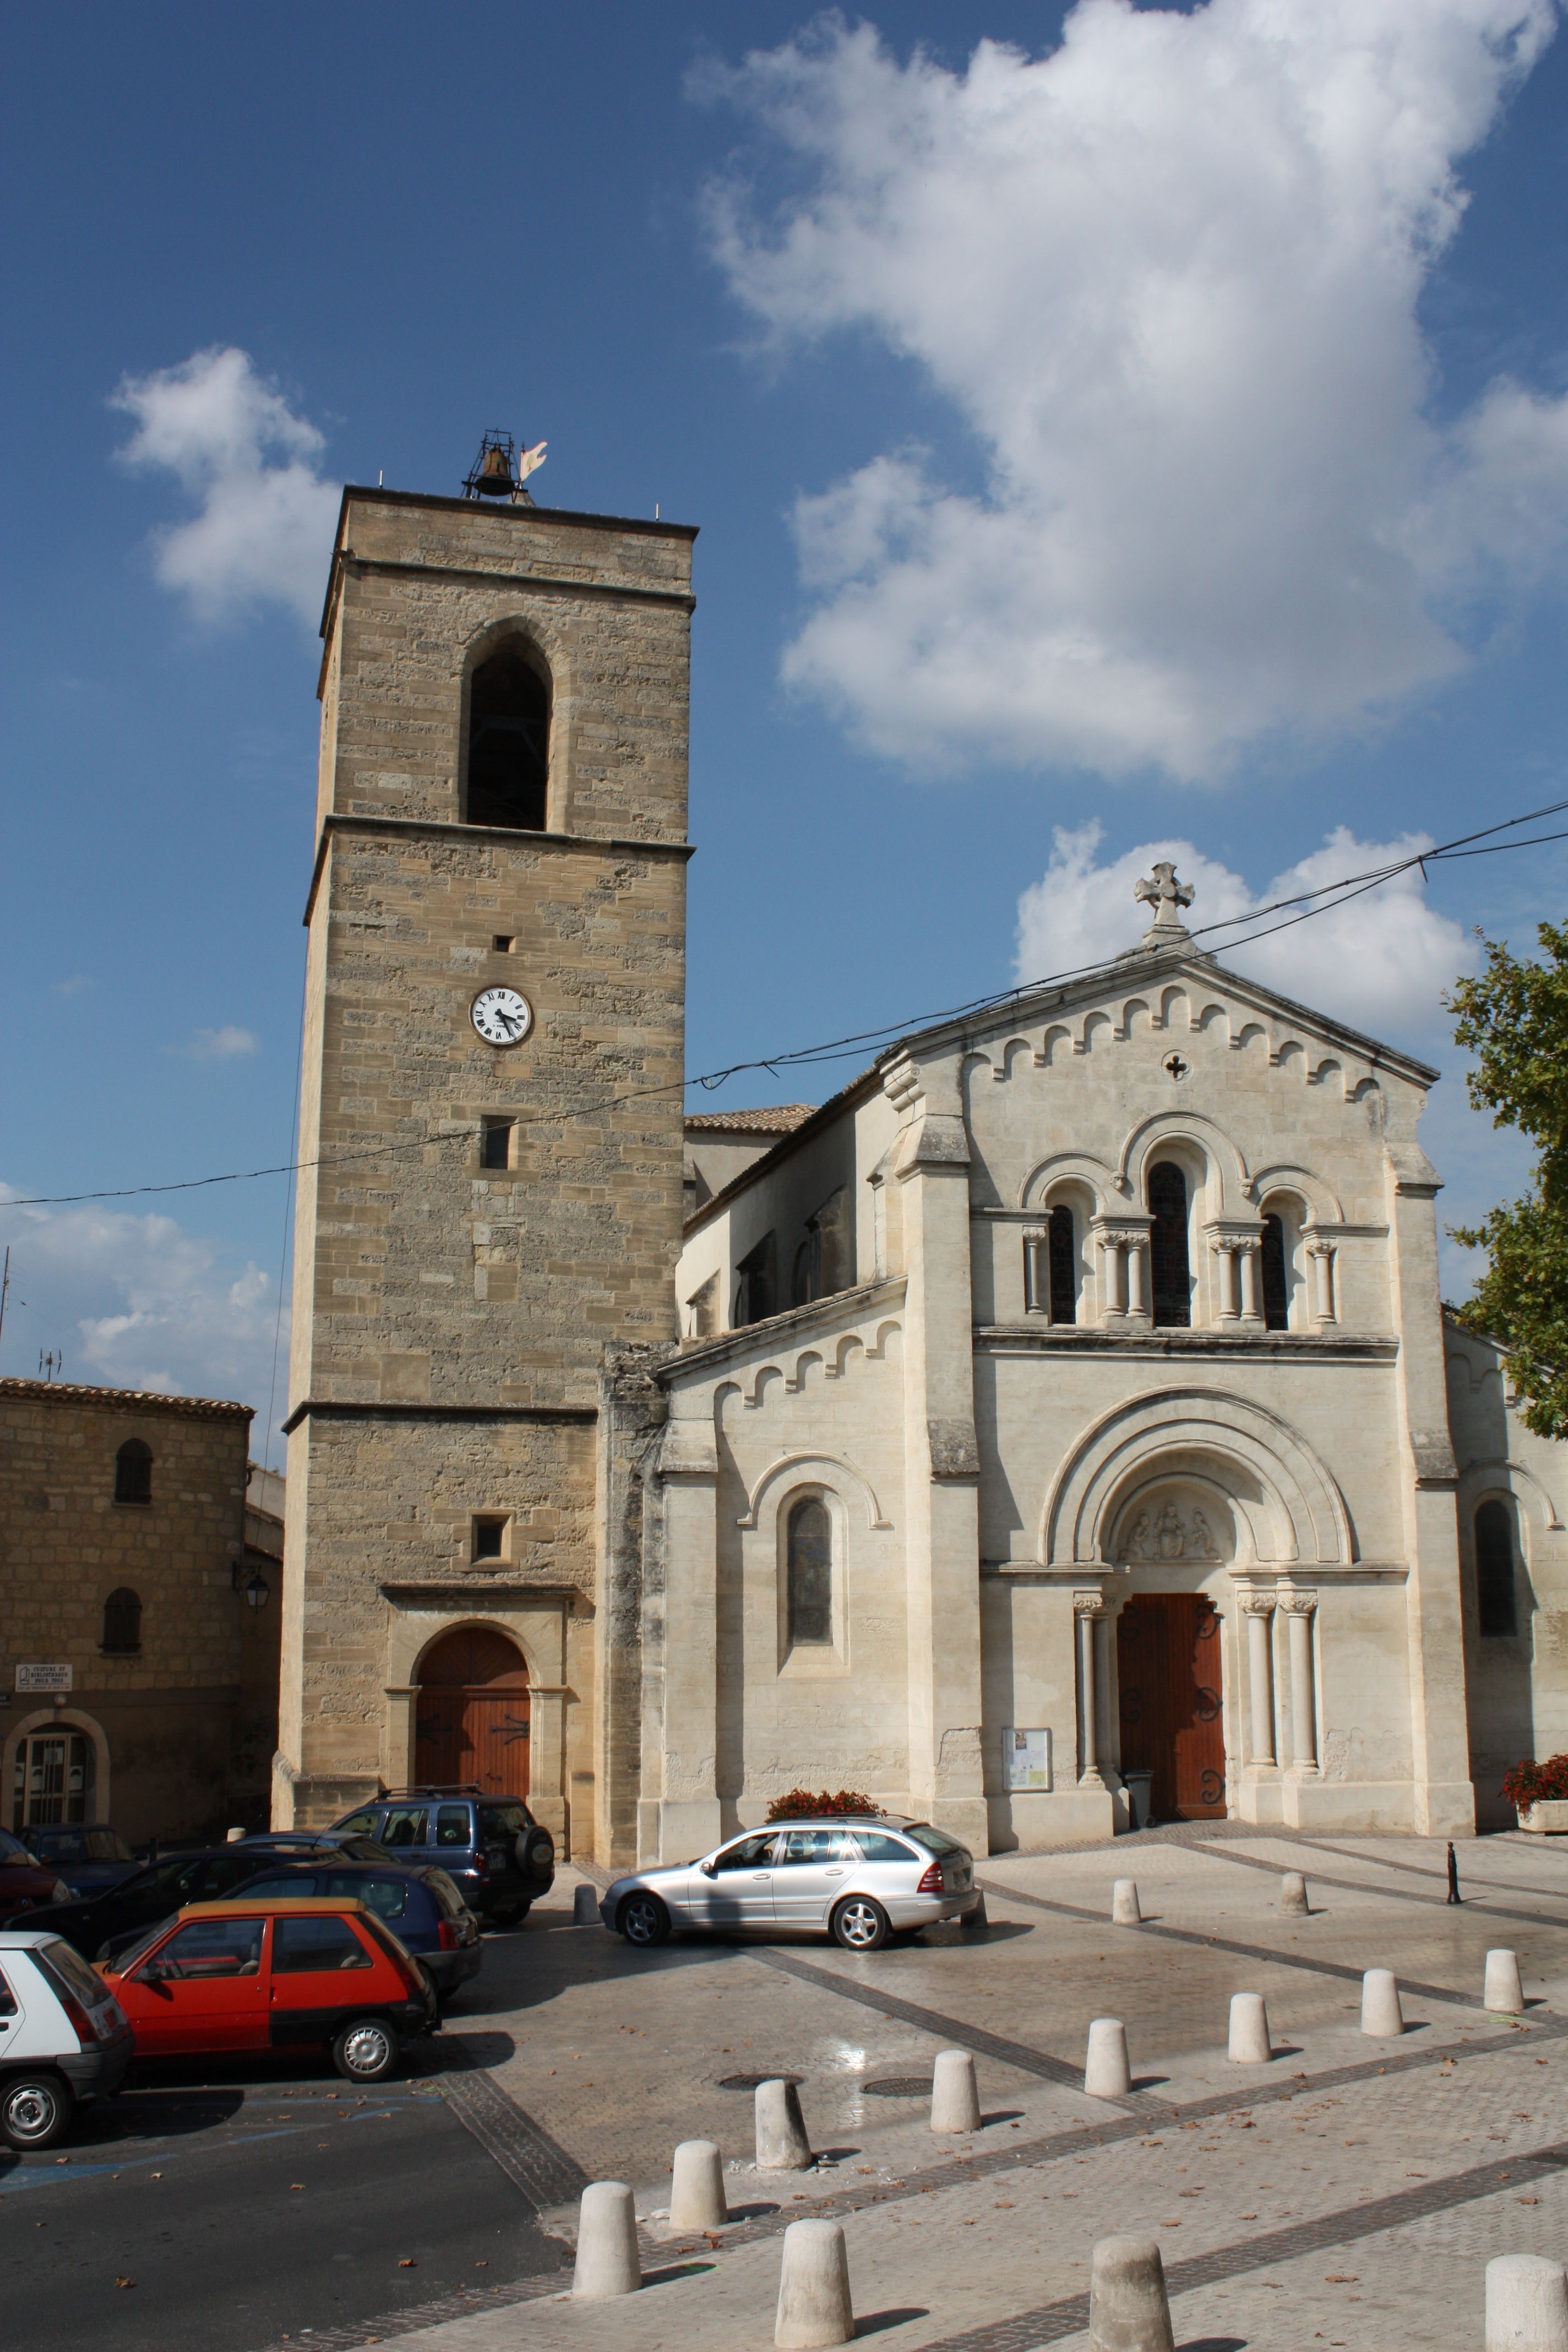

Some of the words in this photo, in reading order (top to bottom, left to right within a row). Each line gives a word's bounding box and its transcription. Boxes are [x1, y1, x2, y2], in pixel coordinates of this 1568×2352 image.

[487, 992, 494, 1001] XI
[476, 1019, 486, 1028] VIII
[514, 1022, 522, 1031] IV
[484, 1027, 492, 1037] VII
[496, 1031, 502, 1039] VI
